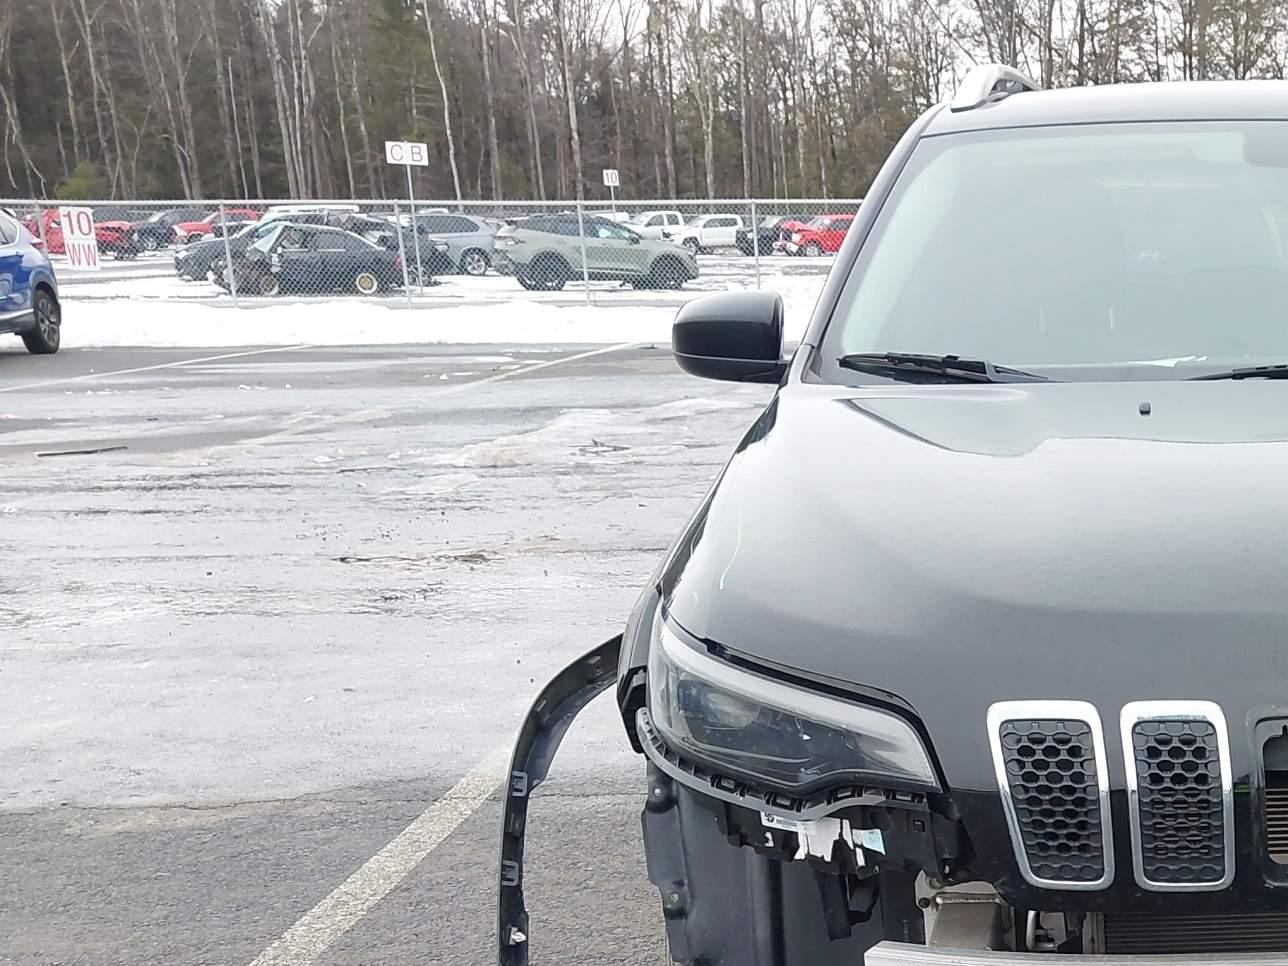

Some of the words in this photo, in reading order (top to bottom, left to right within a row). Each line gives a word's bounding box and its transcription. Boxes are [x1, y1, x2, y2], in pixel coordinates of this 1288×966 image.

[605, 171, 618, 183] 10
[62, 210, 92, 236] 10
[67, 243, 97, 266] WW
